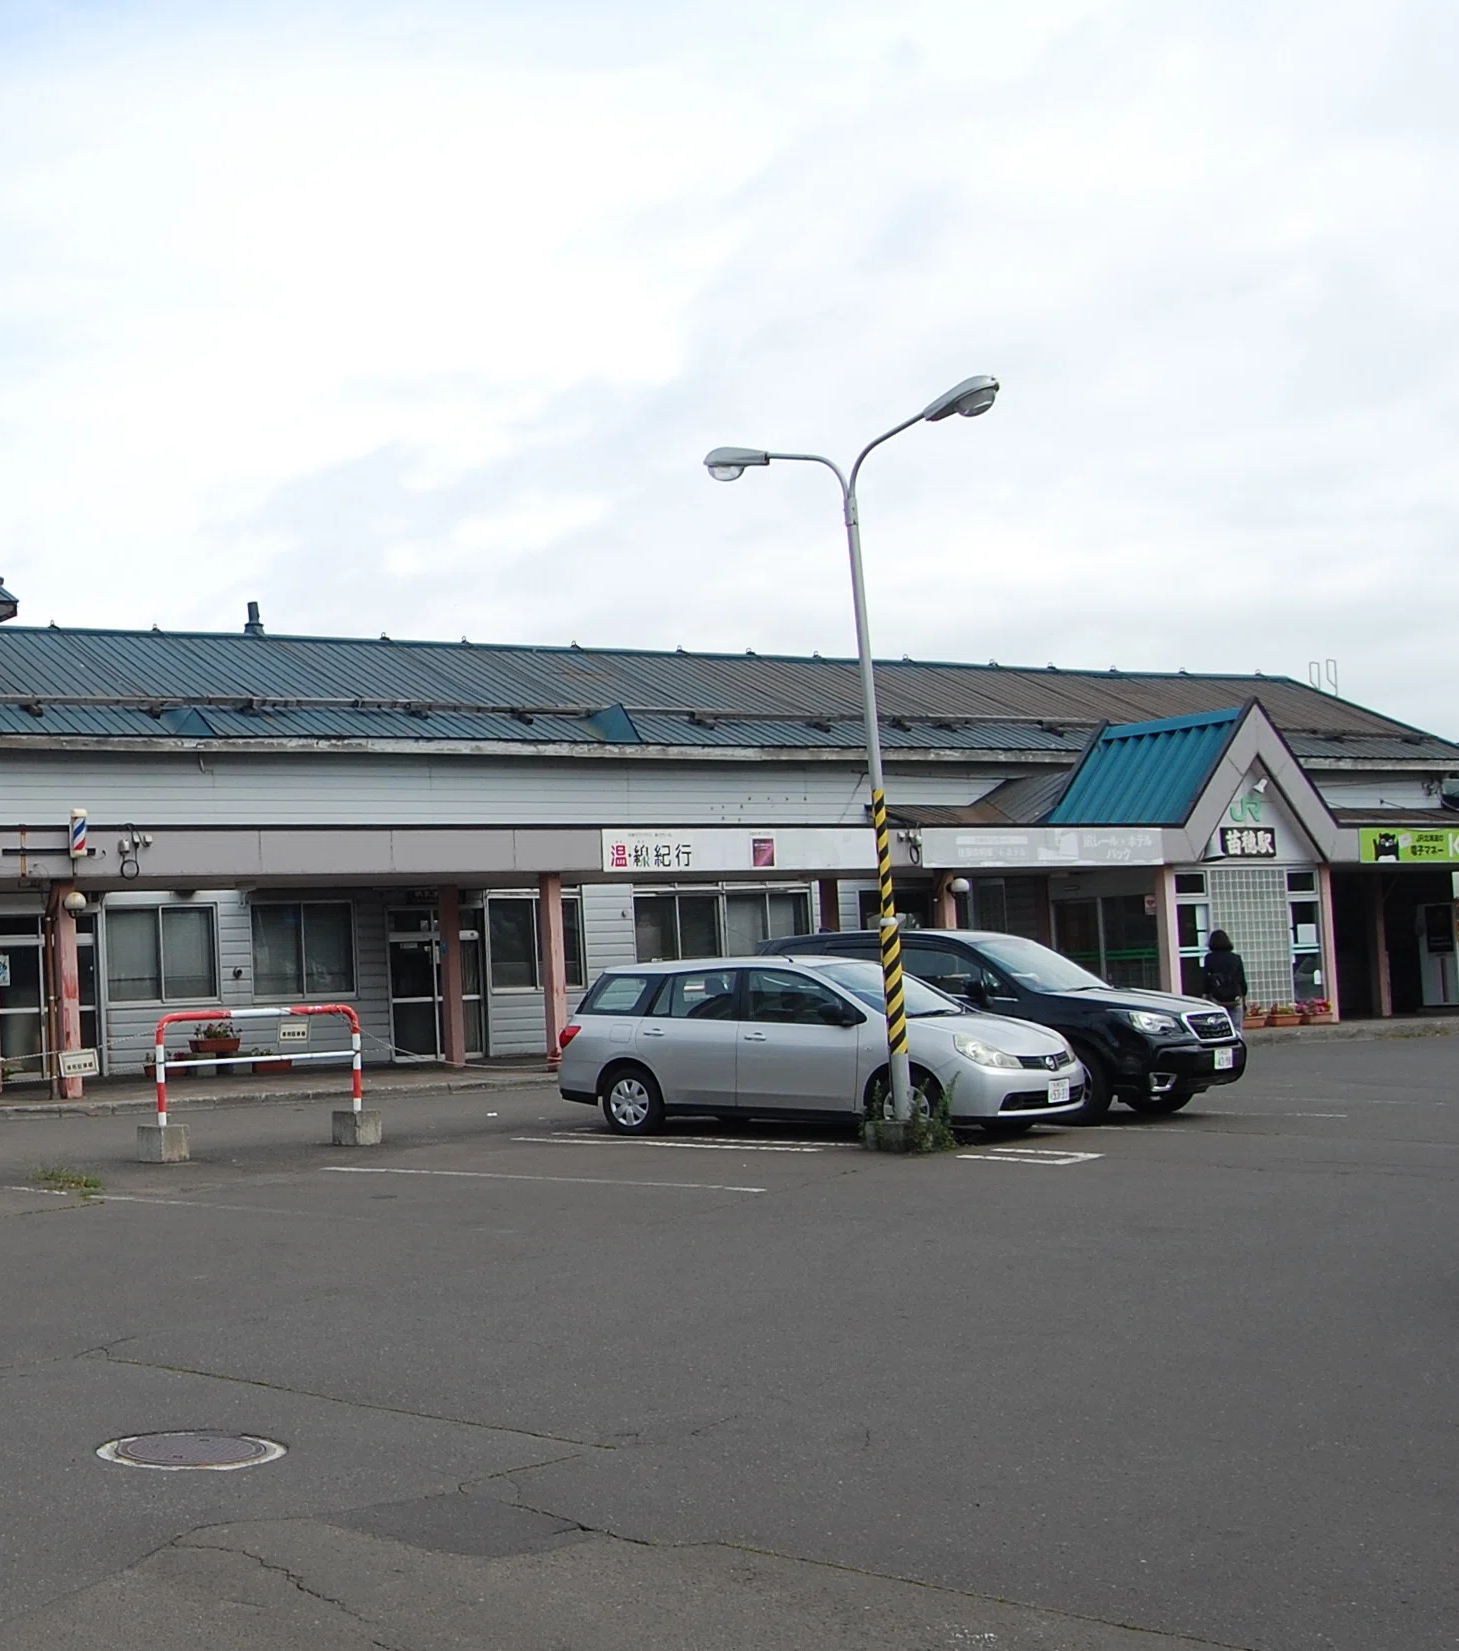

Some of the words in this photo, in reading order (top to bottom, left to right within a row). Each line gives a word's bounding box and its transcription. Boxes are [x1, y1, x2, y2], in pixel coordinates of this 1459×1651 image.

[1230, 796, 1261, 822] JR
[1226, 829, 1274, 855] 苗穂駅
